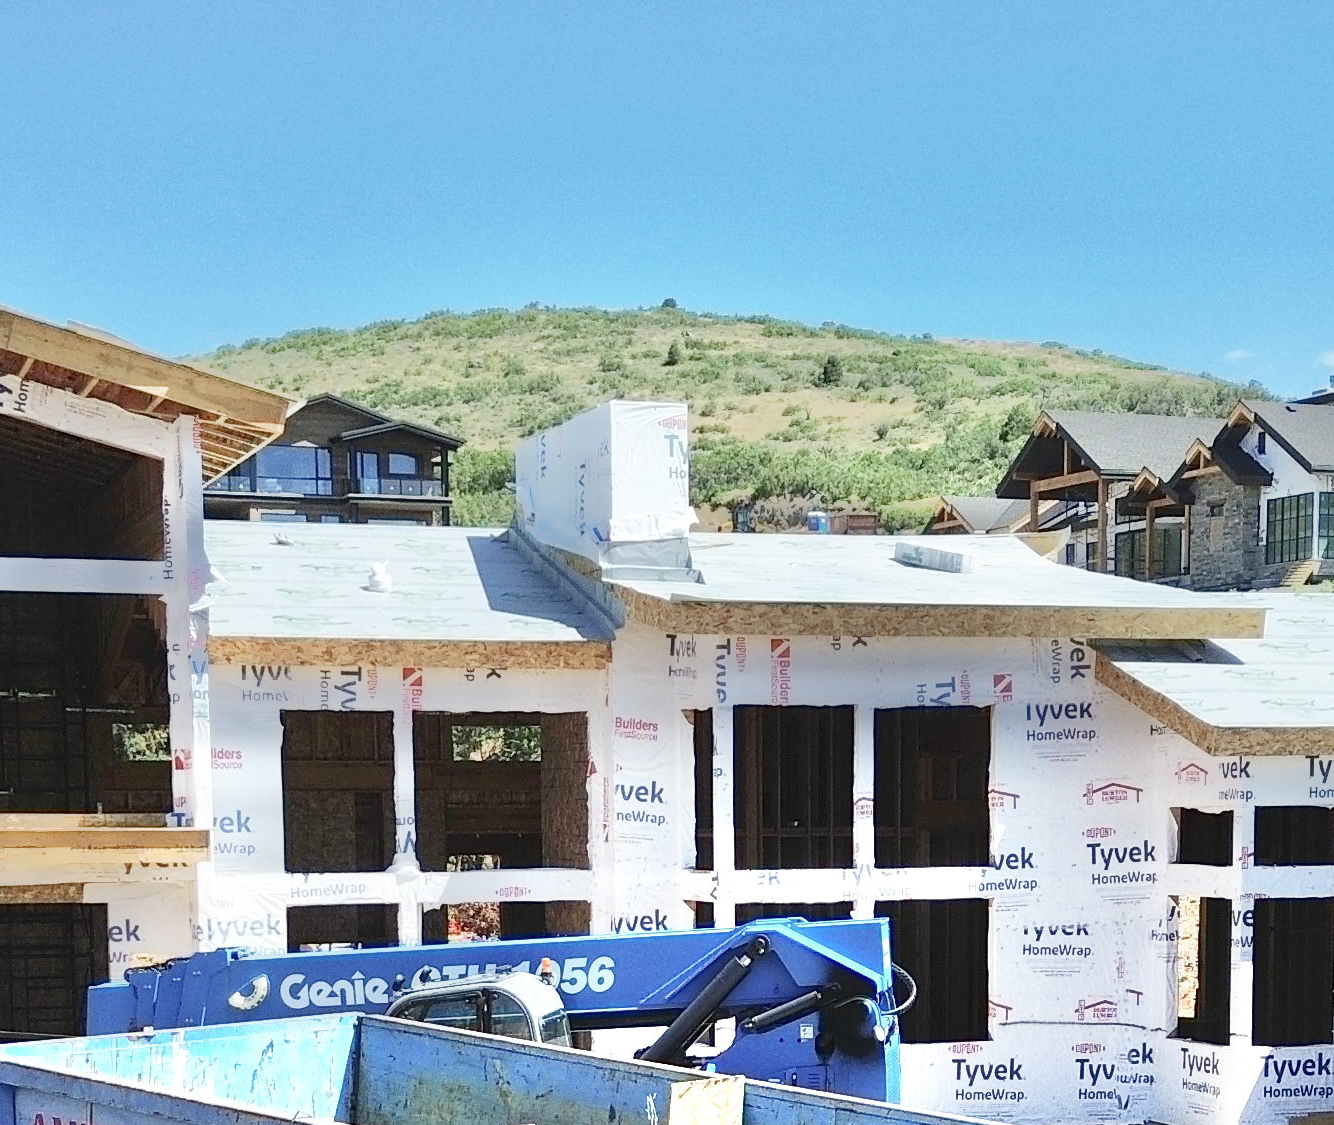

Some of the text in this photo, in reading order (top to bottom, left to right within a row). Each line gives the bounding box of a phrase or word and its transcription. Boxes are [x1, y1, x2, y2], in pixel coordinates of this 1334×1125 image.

[1050, 639, 1061, 684] eWrap
[779, 660, 790, 704] Builder
[615, 717, 658, 732] Builders
[1027, 728, 1096, 742] HomeWrap
[211, 748, 242, 760] lders
[615, 780, 665, 804] vek
[616, 810, 666, 827] eWrap
[994, 847, 1035, 870] vek
[1087, 839, 1156, 870] Tyvek
[290, 881, 366, 899] HomeWrap
[1022, 944, 1092, 957] HomeWrap
[280, 971, 390, 1010] Genie
[952, 1057, 1023, 1086] Tyvek
[1181, 1048, 1219, 1076] Tyvek
[1260, 1053, 1332, 1078] Tyvek
[955, 1089, 1025, 1102] HomeWrap
[1263, 1085, 1334, 1099] HomeWrap
